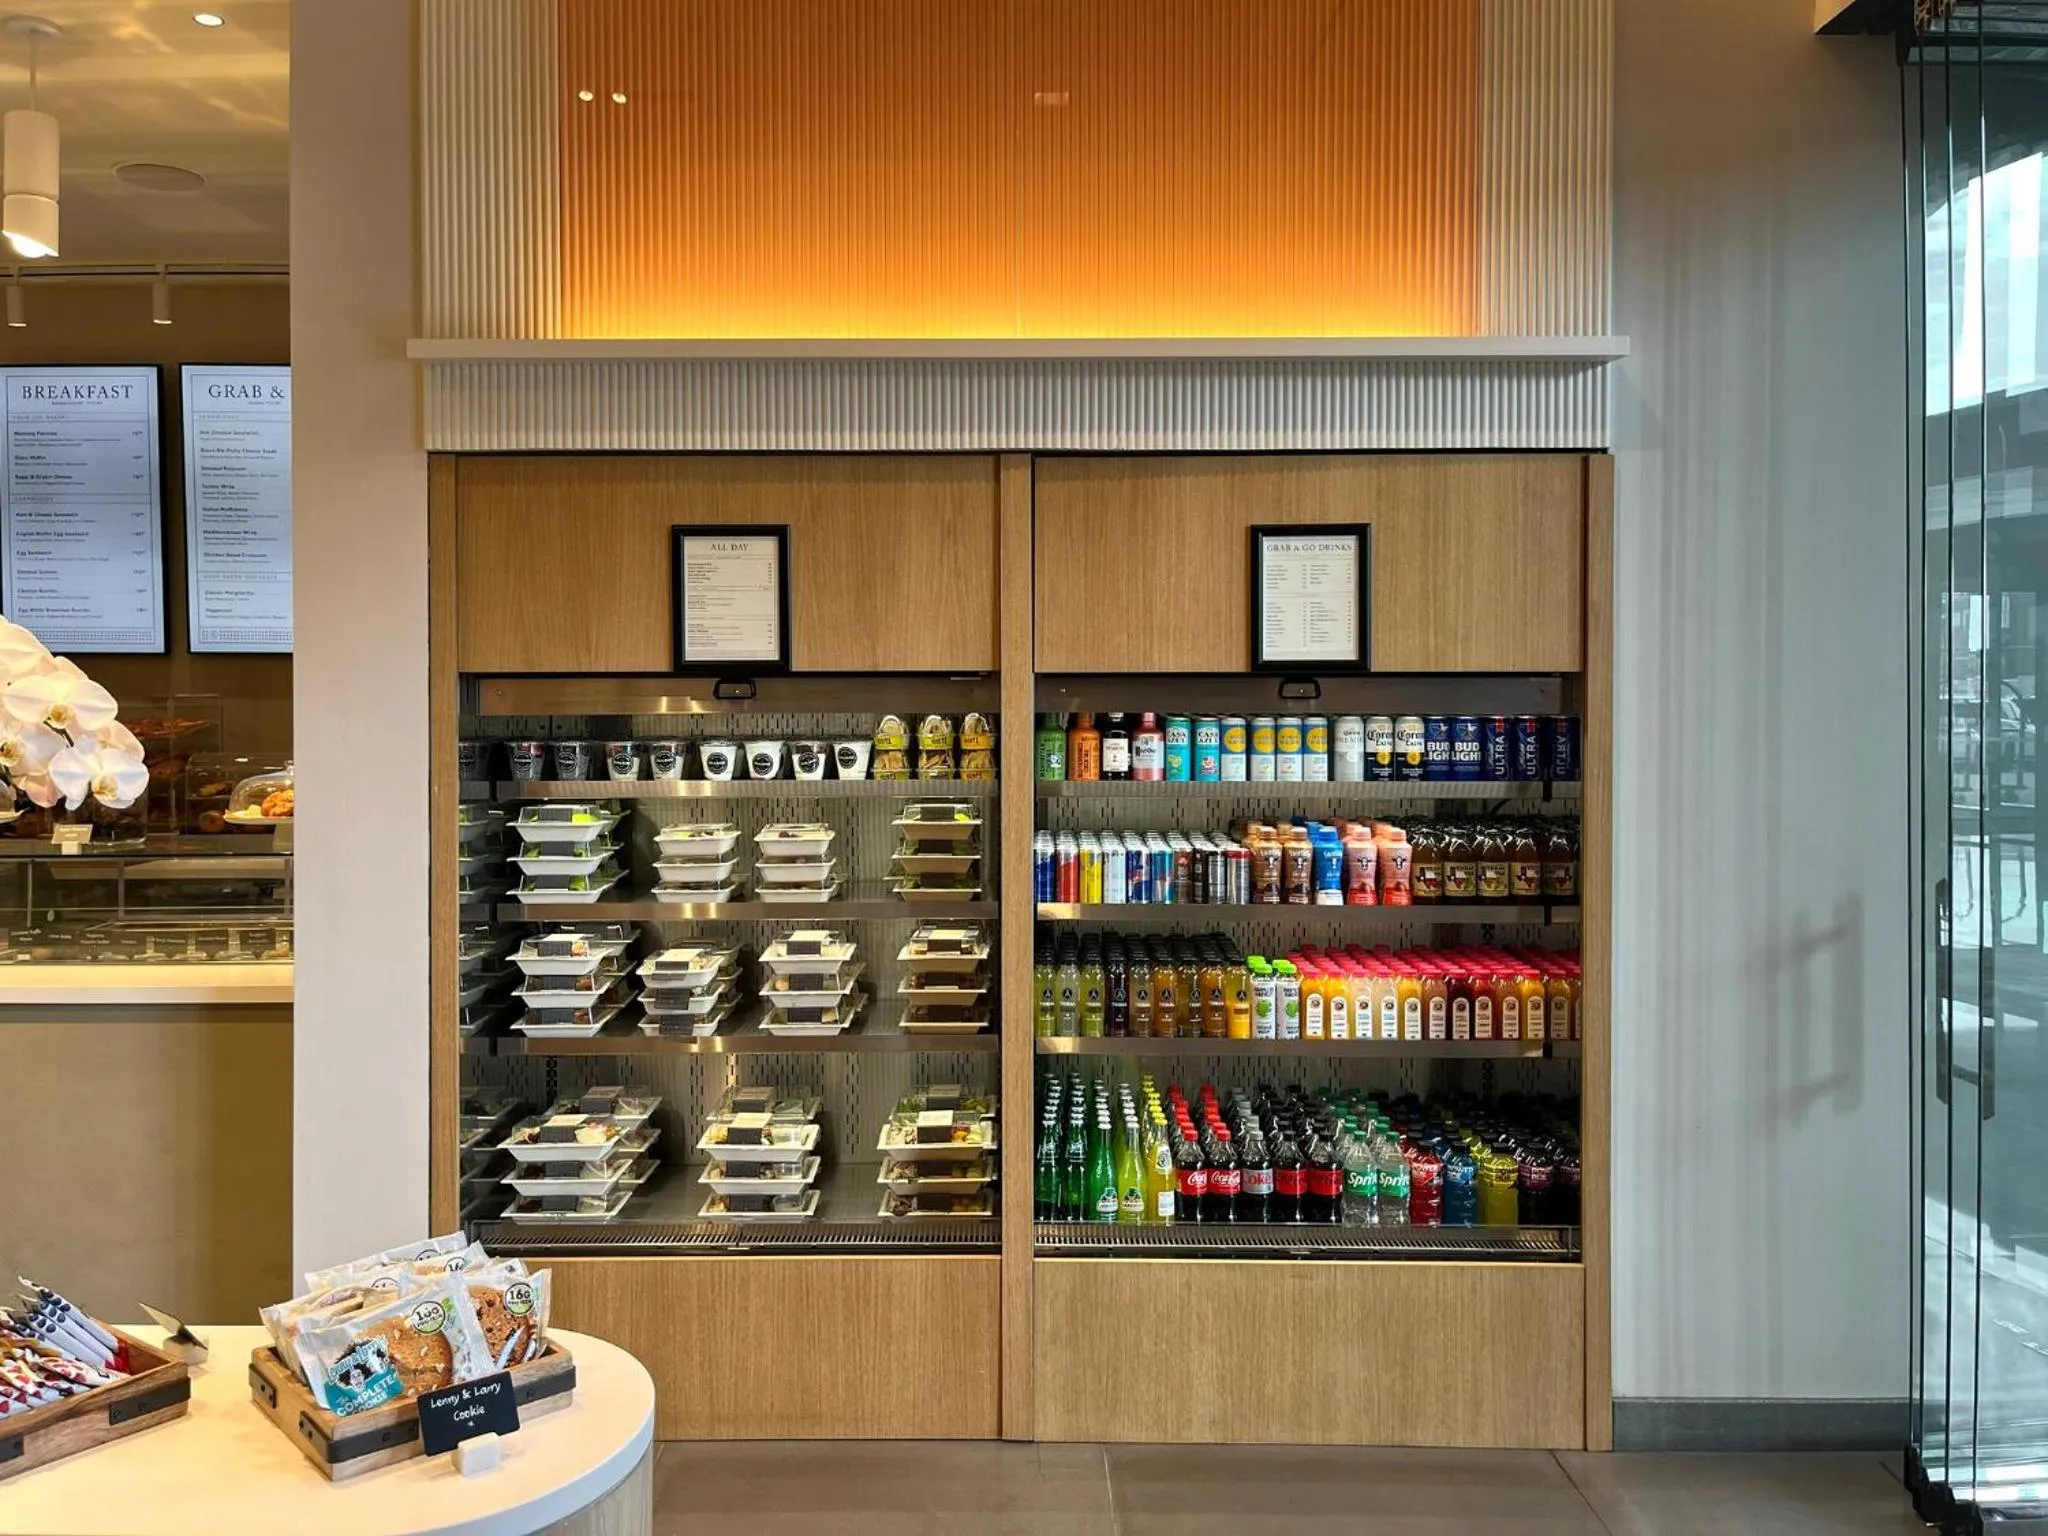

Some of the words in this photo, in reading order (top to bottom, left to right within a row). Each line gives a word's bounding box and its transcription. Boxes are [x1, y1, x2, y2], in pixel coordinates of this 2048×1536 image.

[22, 384, 134, 399] BREAKFAST
[208, 384, 263, 399] GRAB
[270, 384, 286, 399] &
[710, 543, 727, 551] ALL
[731, 543, 749, 551] DAY
[1266, 544, 1291, 552] GRAB
[1302, 544, 1316, 552] GO
[1319, 544, 1352, 552] DRINKS
[1427, 741, 1450, 751] BUD
[1454, 742, 1480, 751] BUD
[1425, 751, 1450, 761] IGH
[1494, 735, 1505, 775] ULTRA
[1526, 735, 1536, 775] ULTRA
[509, 1289, 531, 1300] 16G
[337, 1375, 396, 1417] COMPLETE
[431, 1393, 459, 1409] Lenny
[462, 1389, 472, 1400] &
[474, 1382, 501, 1396] Larry
[454, 1404, 486, 1421] Cookie
